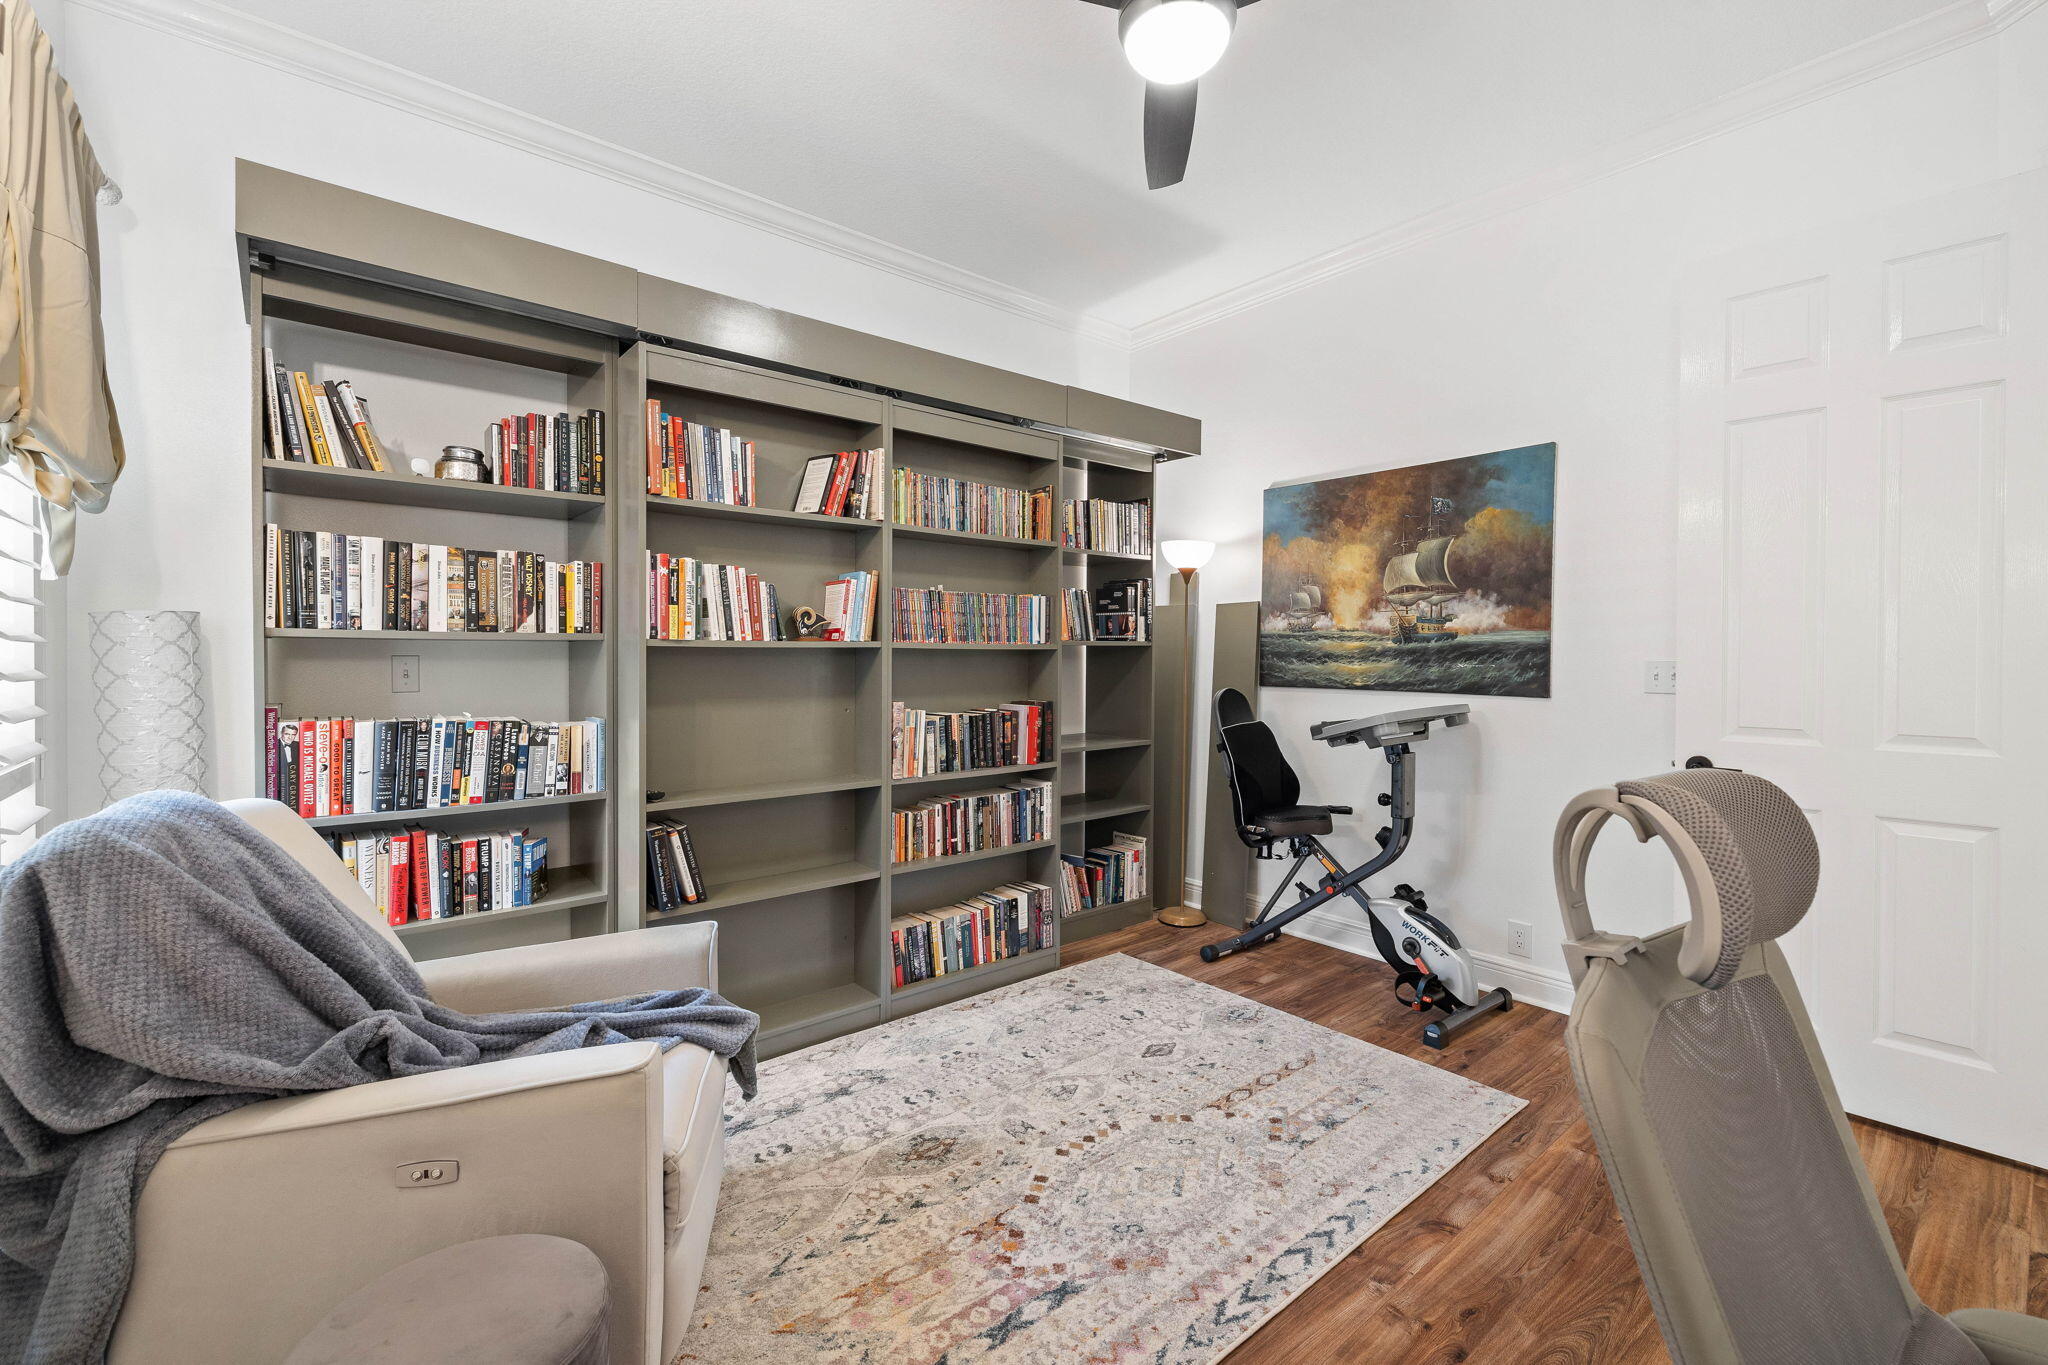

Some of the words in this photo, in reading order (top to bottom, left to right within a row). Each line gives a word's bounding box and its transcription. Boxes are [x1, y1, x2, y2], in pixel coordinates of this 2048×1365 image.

[320, 556, 330, 571] MADE
[320, 578, 330, 595] JAPAN
[467, 580, 476, 590] TED
[503, 562, 513, 598] TITAN
[266, 712, 275, 729] Writing
[267, 729, 275, 749] Effective
[303, 731, 314, 746] WHO
[319, 723, 329, 764] steve-o
[417, 734, 429, 751] ELON
[503, 722, 512, 760] HOLLYWOOD
[510, 729, 518, 743] LION
[416, 752, 428, 770] MUSK
[492, 734, 502, 786] CASANOVA
[535, 748, 545, 762] The
[303, 755, 314, 782] MICHAEL
[333, 766, 340, 775] TO
[442, 752, 452, 782] BUSINESS
[534, 763, 544, 783] Chief
[303, 784, 314, 805] OVITZ?
[392, 841, 400, 866] BRANSON
[400, 841, 408, 864] RICHARD
[418, 843, 426, 855] THE
[441, 842, 449, 869] REWORK
[682, 830, 690, 844] WORK
[687, 850, 696, 868] SYSTEM
[365, 844, 374, 888] WINNERS
[419, 857, 427, 870] END
[662, 858, 672, 889] SNOWBALL
[420, 872, 427, 880] OF
[421, 883, 429, 906] POWER
